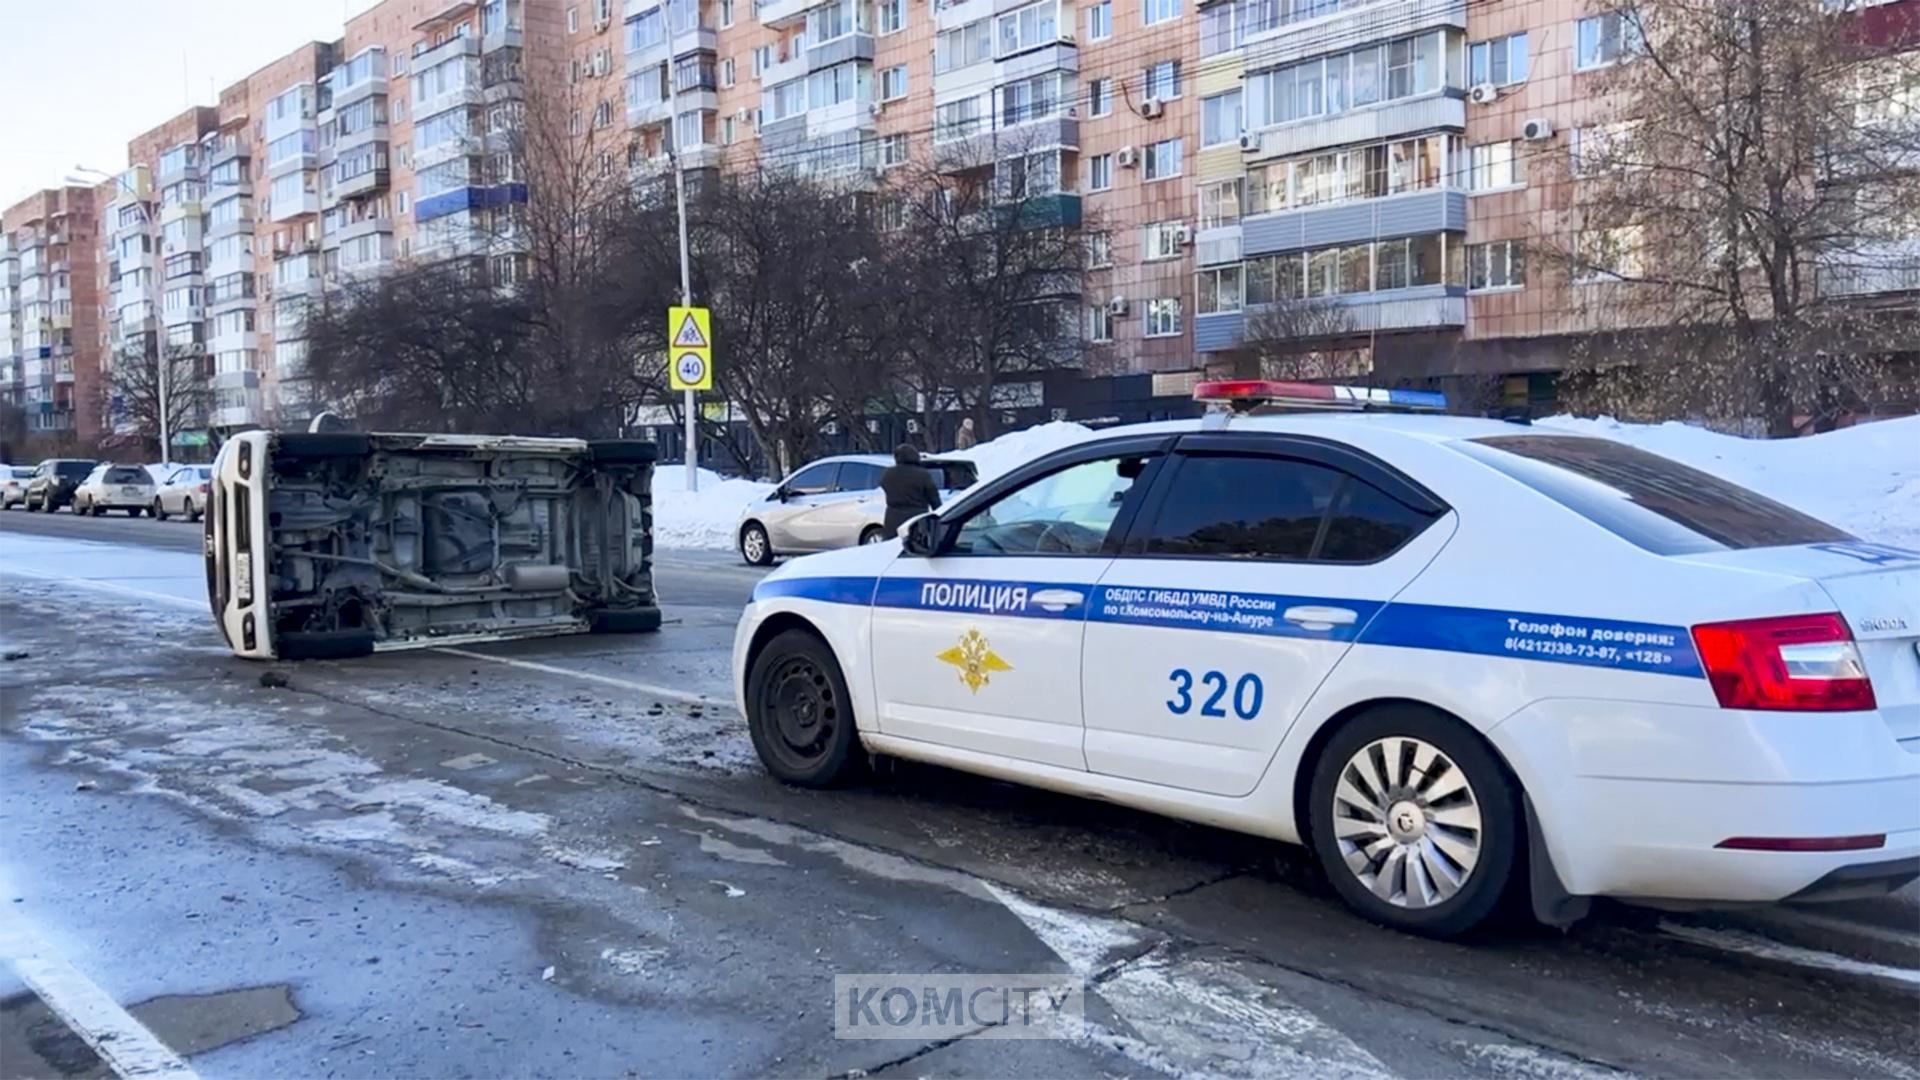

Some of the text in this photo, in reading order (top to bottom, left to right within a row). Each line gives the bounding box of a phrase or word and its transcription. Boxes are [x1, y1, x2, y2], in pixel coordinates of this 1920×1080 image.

[682, 362, 700, 376] 40
[921, 583, 1028, 613] ПОЛИЦИЯ
[1104, 605, 1117, 615] по
[1105, 588, 1276, 611] ОБДПС ГИБДД УМВД России
[1507, 618, 1675, 647] Телефон доверия:
[1166, 668, 1264, 721] 320
